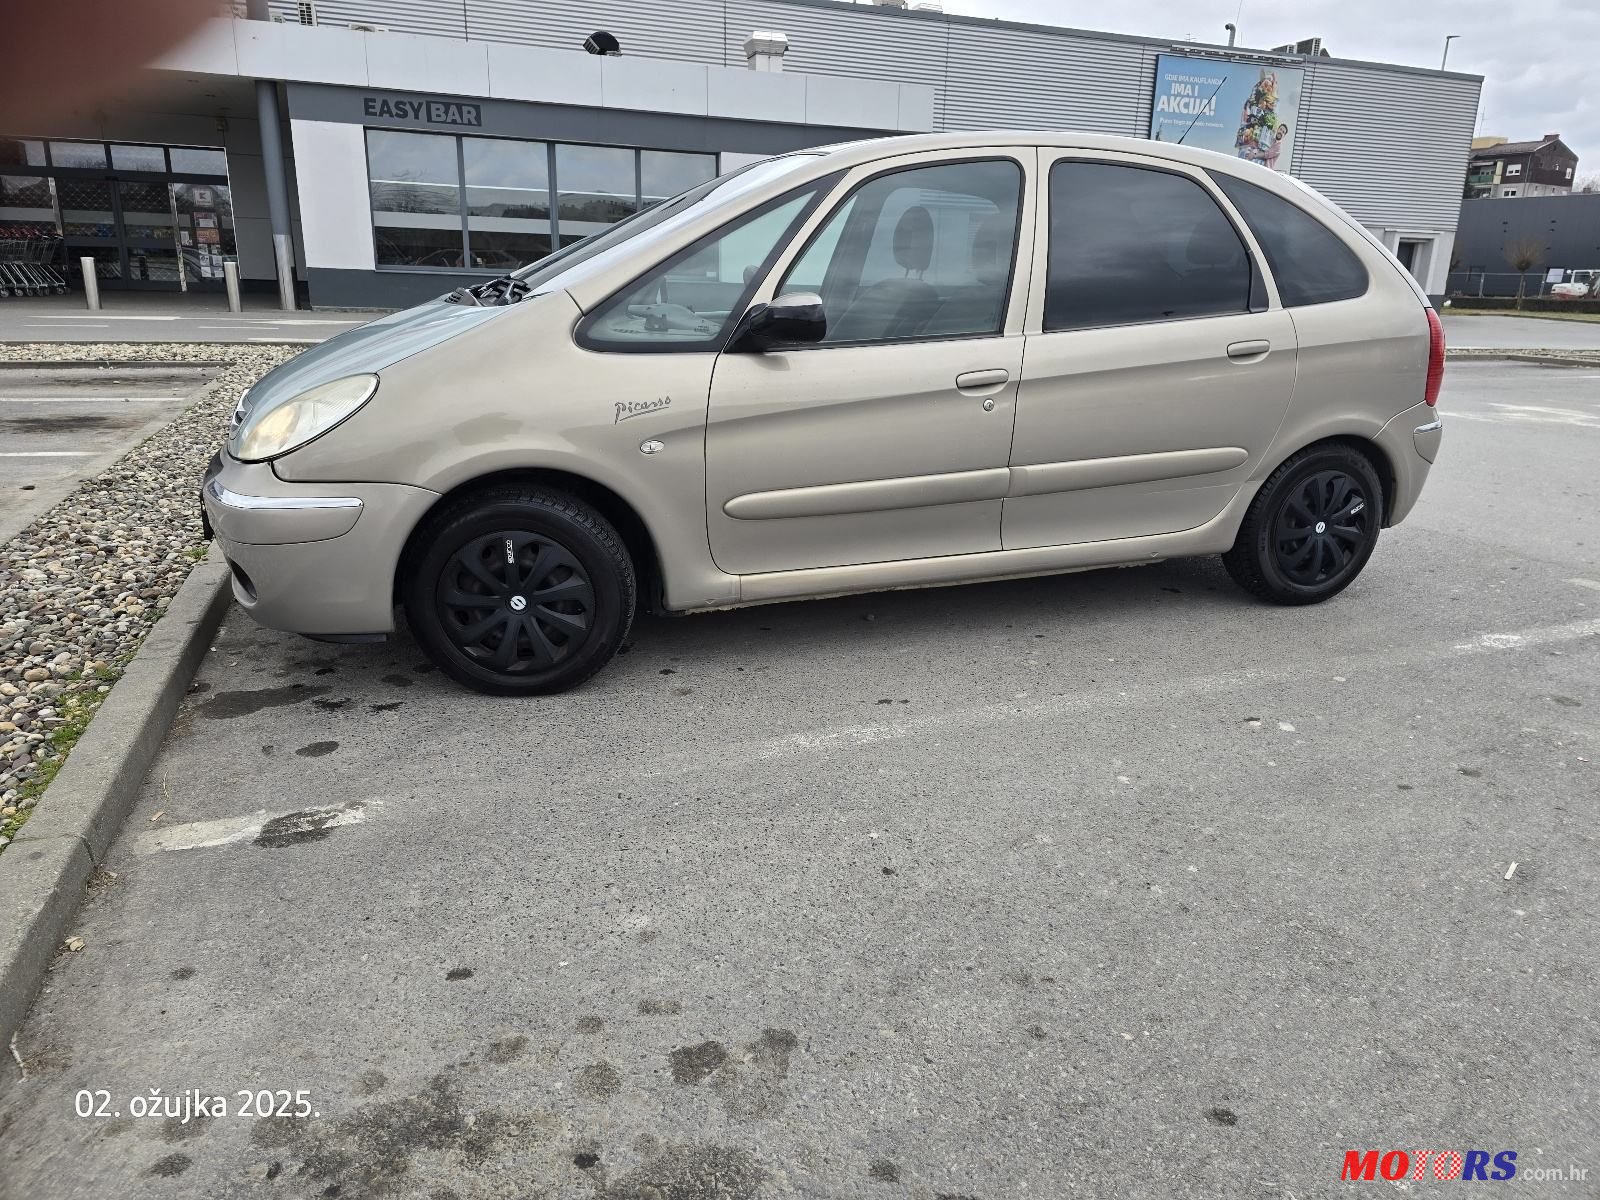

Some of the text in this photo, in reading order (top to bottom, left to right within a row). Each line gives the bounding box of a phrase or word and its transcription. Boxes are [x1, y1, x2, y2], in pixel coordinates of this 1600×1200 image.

[1171, 82, 1199, 97] IMA I
[363, 97, 478, 125] EASY BAR
[1156, 95, 1217, 117] AKCIJA!
